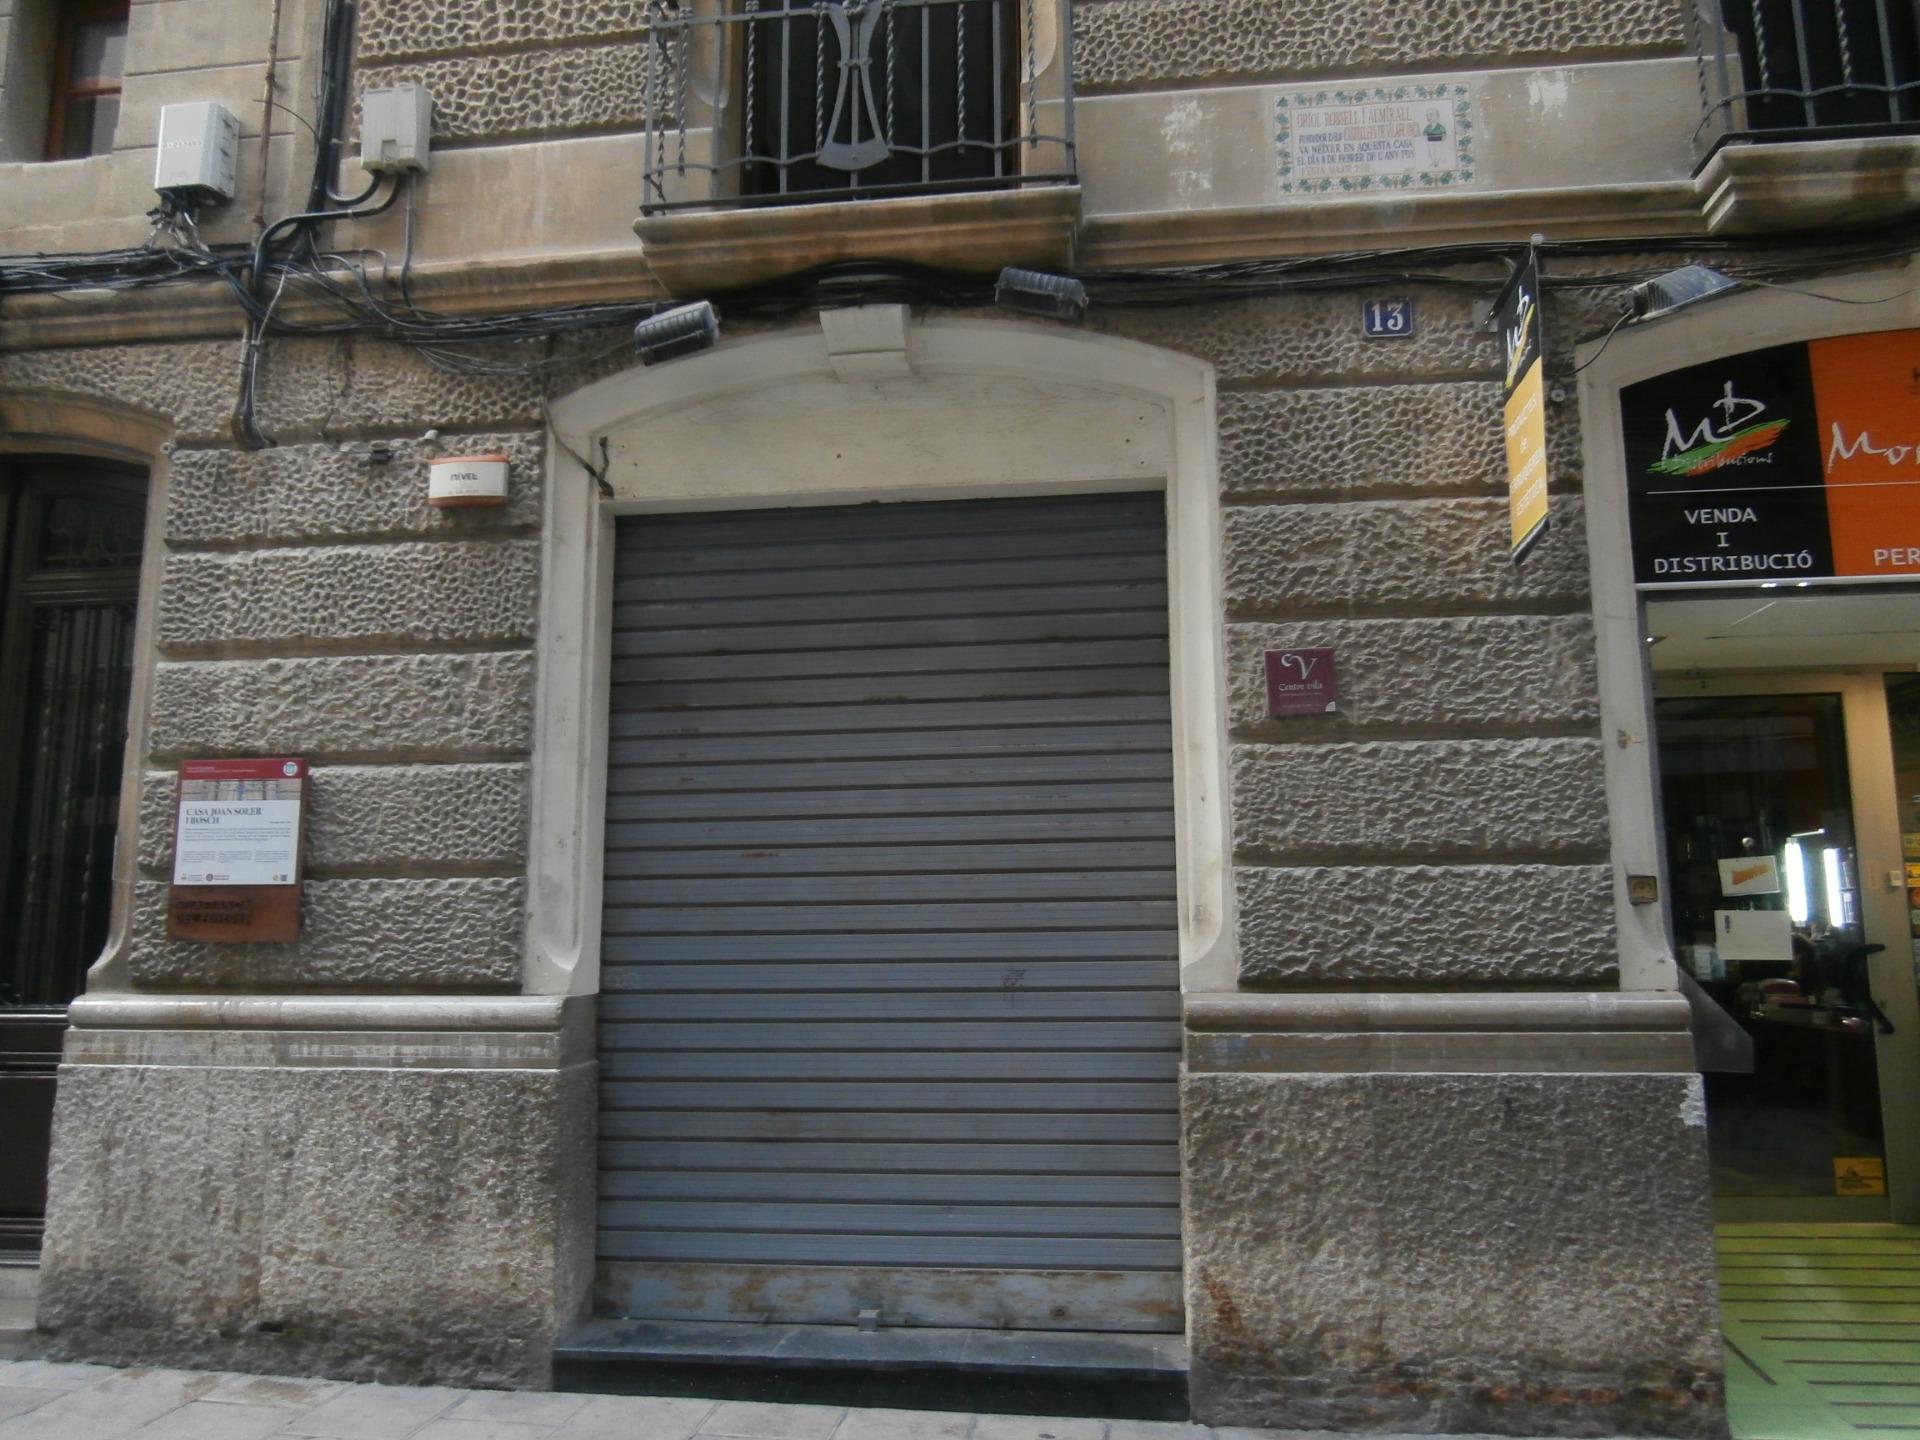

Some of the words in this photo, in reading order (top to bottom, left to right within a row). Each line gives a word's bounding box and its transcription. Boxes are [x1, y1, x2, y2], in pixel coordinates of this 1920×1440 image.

[1358, 140, 1391, 152] AQUESTA
[1393, 138, 1414, 149] CASA
[1371, 303, 1404, 332] 13
[1684, 507, 1757, 525] VENDA
[1716, 532, 1730, 547] I
[1654, 549, 1813, 574] DISTRIBUCIÓ
[186, 807, 208, 816] CASA
[210, 807, 234, 817] JOAN
[234, 807, 262, 816] SOLER
[190, 816, 220, 825] BOSCH
